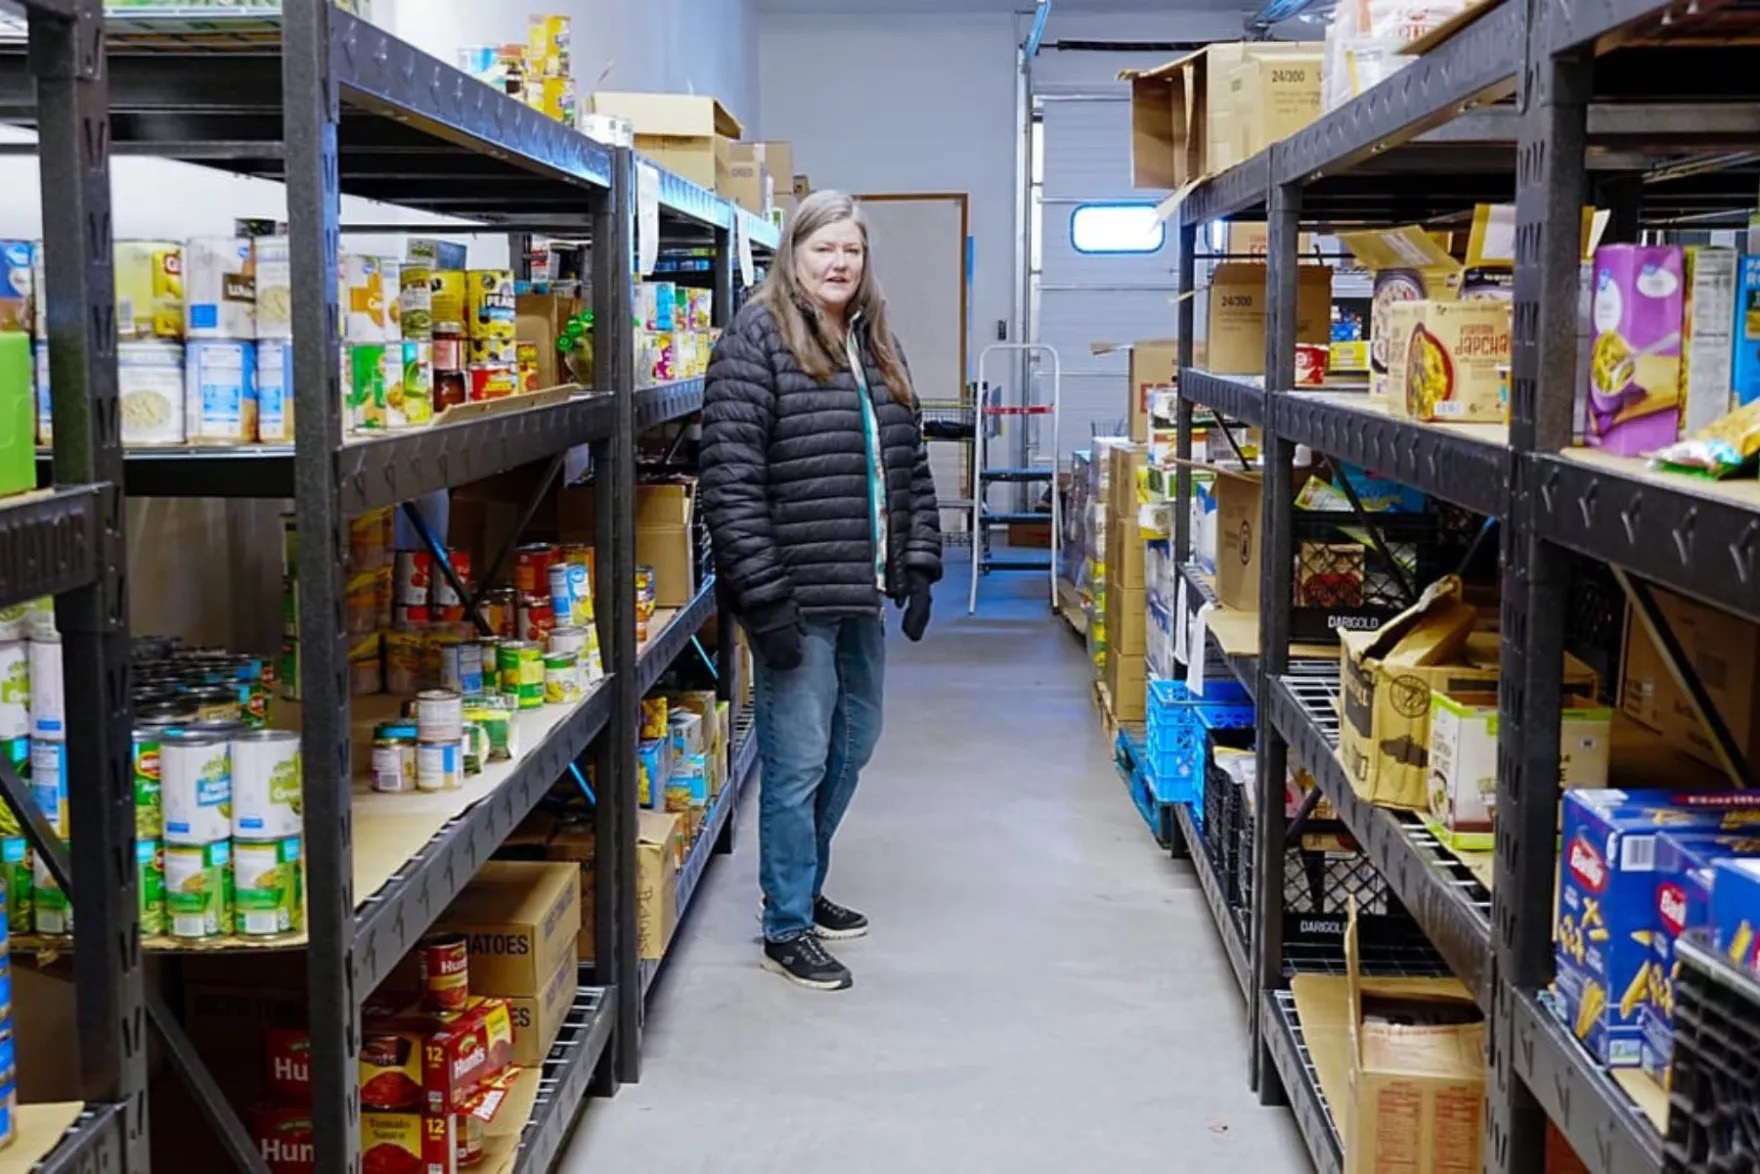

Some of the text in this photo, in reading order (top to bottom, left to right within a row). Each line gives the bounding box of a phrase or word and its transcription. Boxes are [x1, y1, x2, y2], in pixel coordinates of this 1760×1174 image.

[1328, 615, 1380, 630] DARIGOLD
[425, 1046, 444, 1063] 12
[425, 1118, 445, 1134] 12
